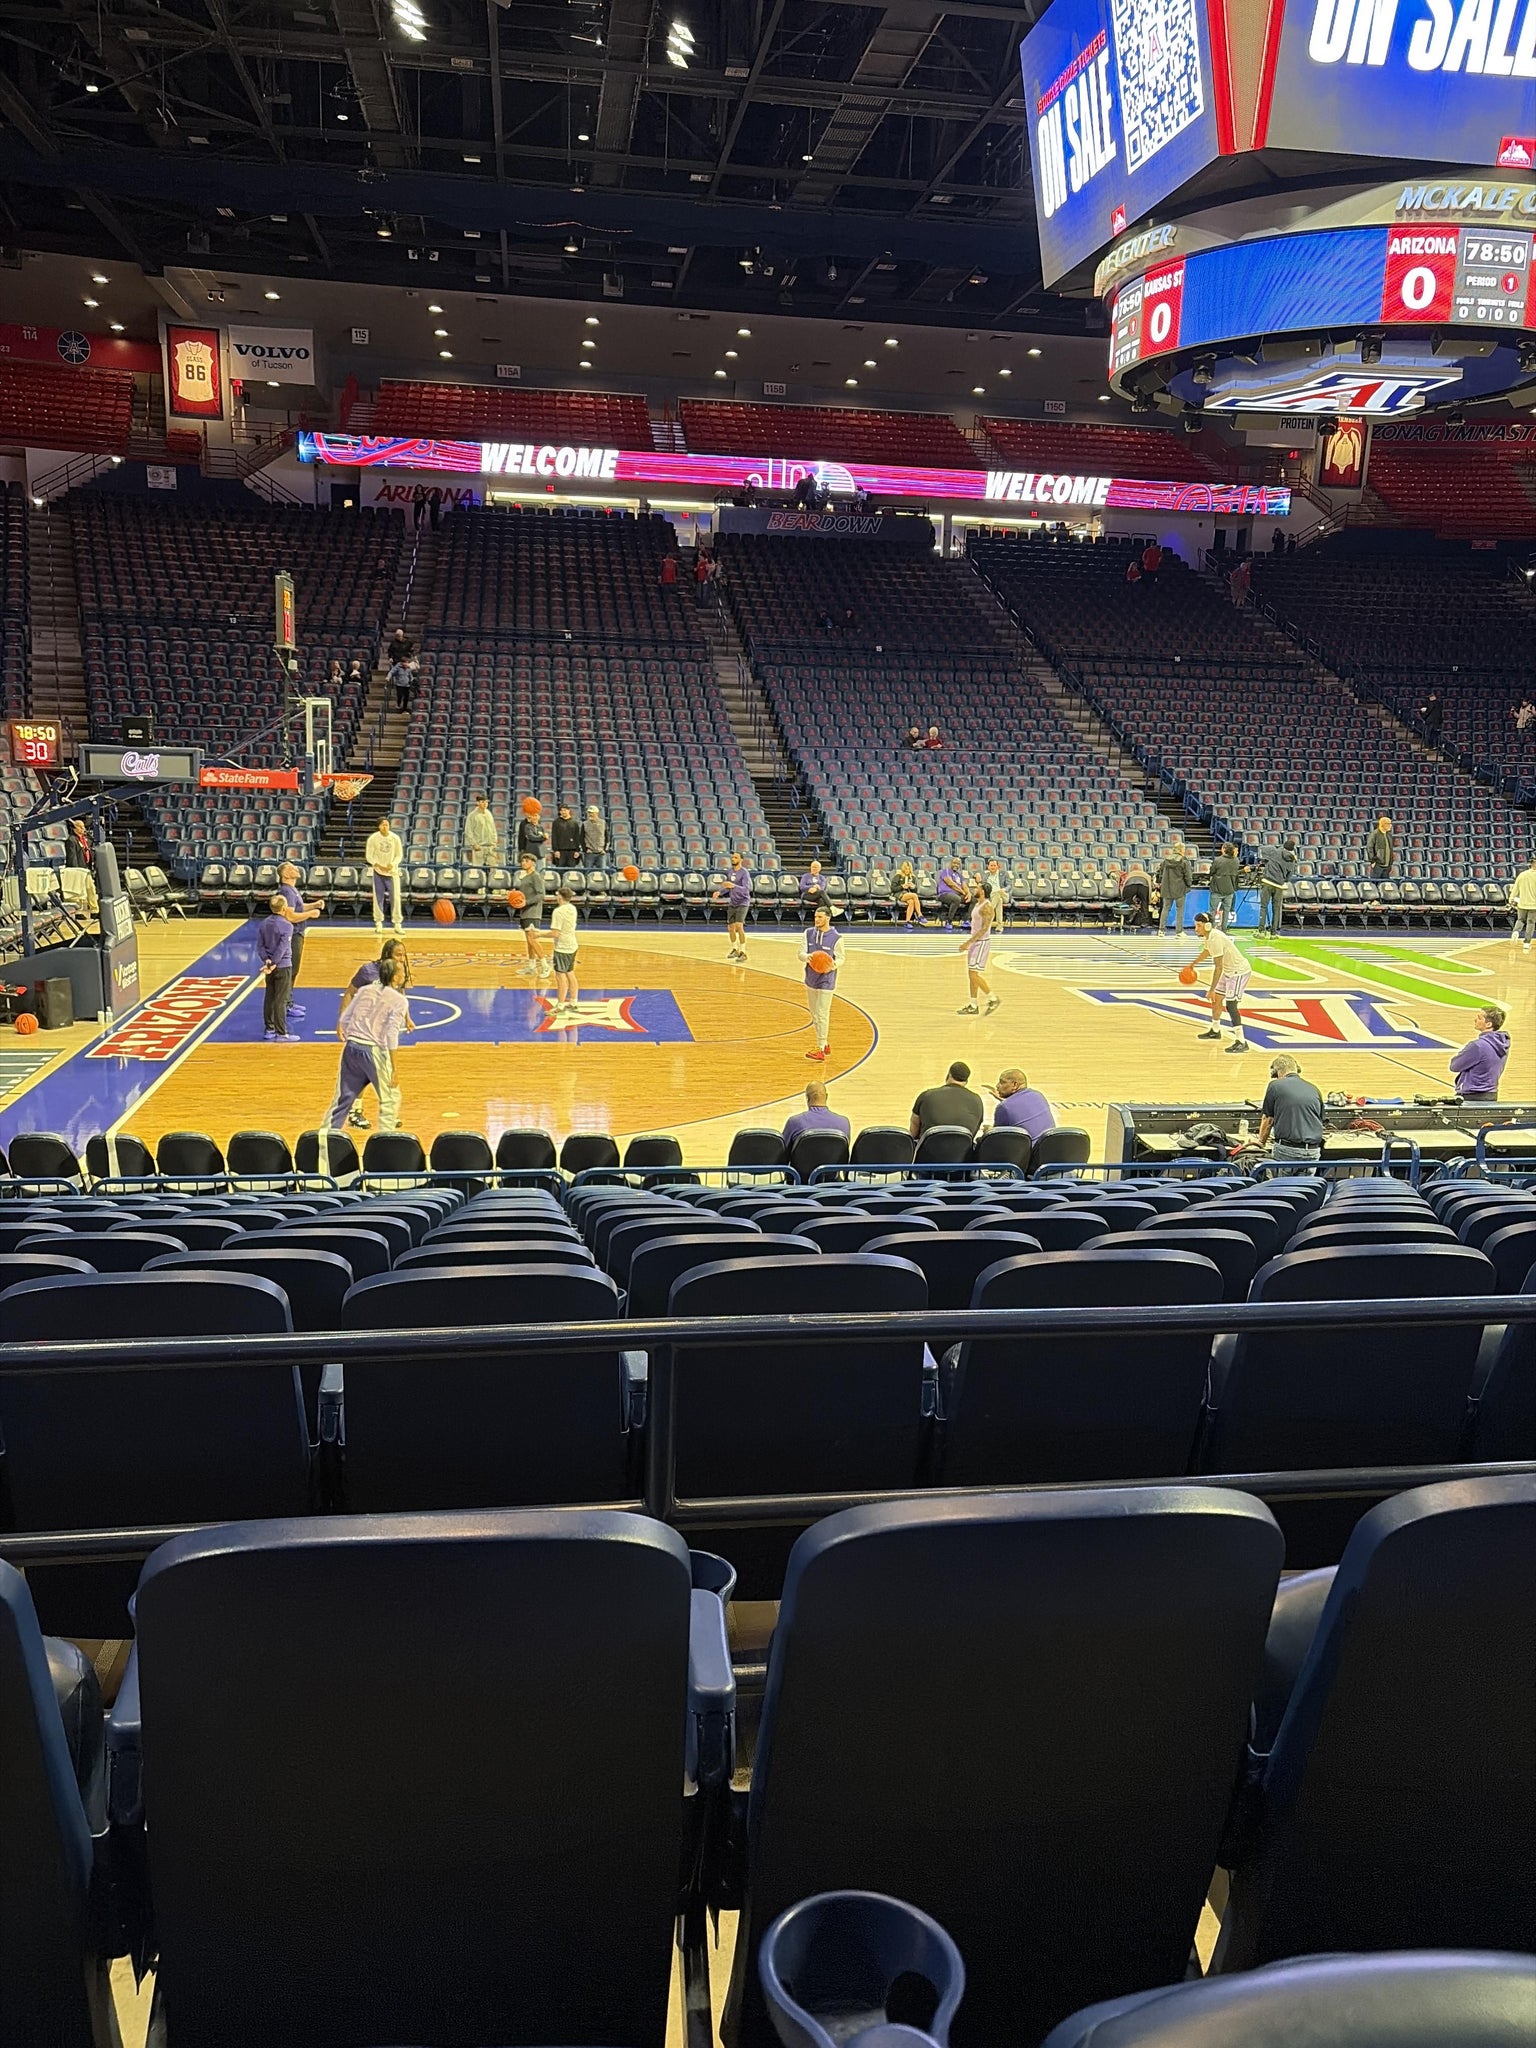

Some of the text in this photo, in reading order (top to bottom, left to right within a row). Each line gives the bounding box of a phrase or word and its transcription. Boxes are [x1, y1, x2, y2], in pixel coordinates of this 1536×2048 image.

[1077, 29, 1106, 75] TICKETS
[1037, 47, 1117, 218] ON SALE
[1397, 186, 1519, 211] MCKALE
[1114, 224, 1175, 269] CENTER
[1389, 236, 1456, 255] ARIZONA
[1466, 242, 1526, 264] 78:50
[1144, 269, 1184, 298] KANSAS ST
[1402, 266, 1436, 310] 0
[1466, 274, 1497, 288] PERIOD
[1151, 302, 1171, 343] 0
[22, 329, 38, 341] 114
[354, 330, 367, 339] 115
[233, 343, 310, 360] VOLVO
[185, 363, 206, 381] 86
[251, 359, 293, 370] of Tucson
[498, 367, 519, 377] 115A
[765, 384, 785, 394] 115B
[1046, 401, 1064, 411] 115C
[1280, 416, 1315, 431] PROTEIN
[481, 442, 619, 479] WELCOME
[986, 471, 1113, 506] WELCOME
[25, 741, 48, 760] 30
[121, 751, 159, 777] Cats
[84, 975, 251, 1061] ARIZONA
